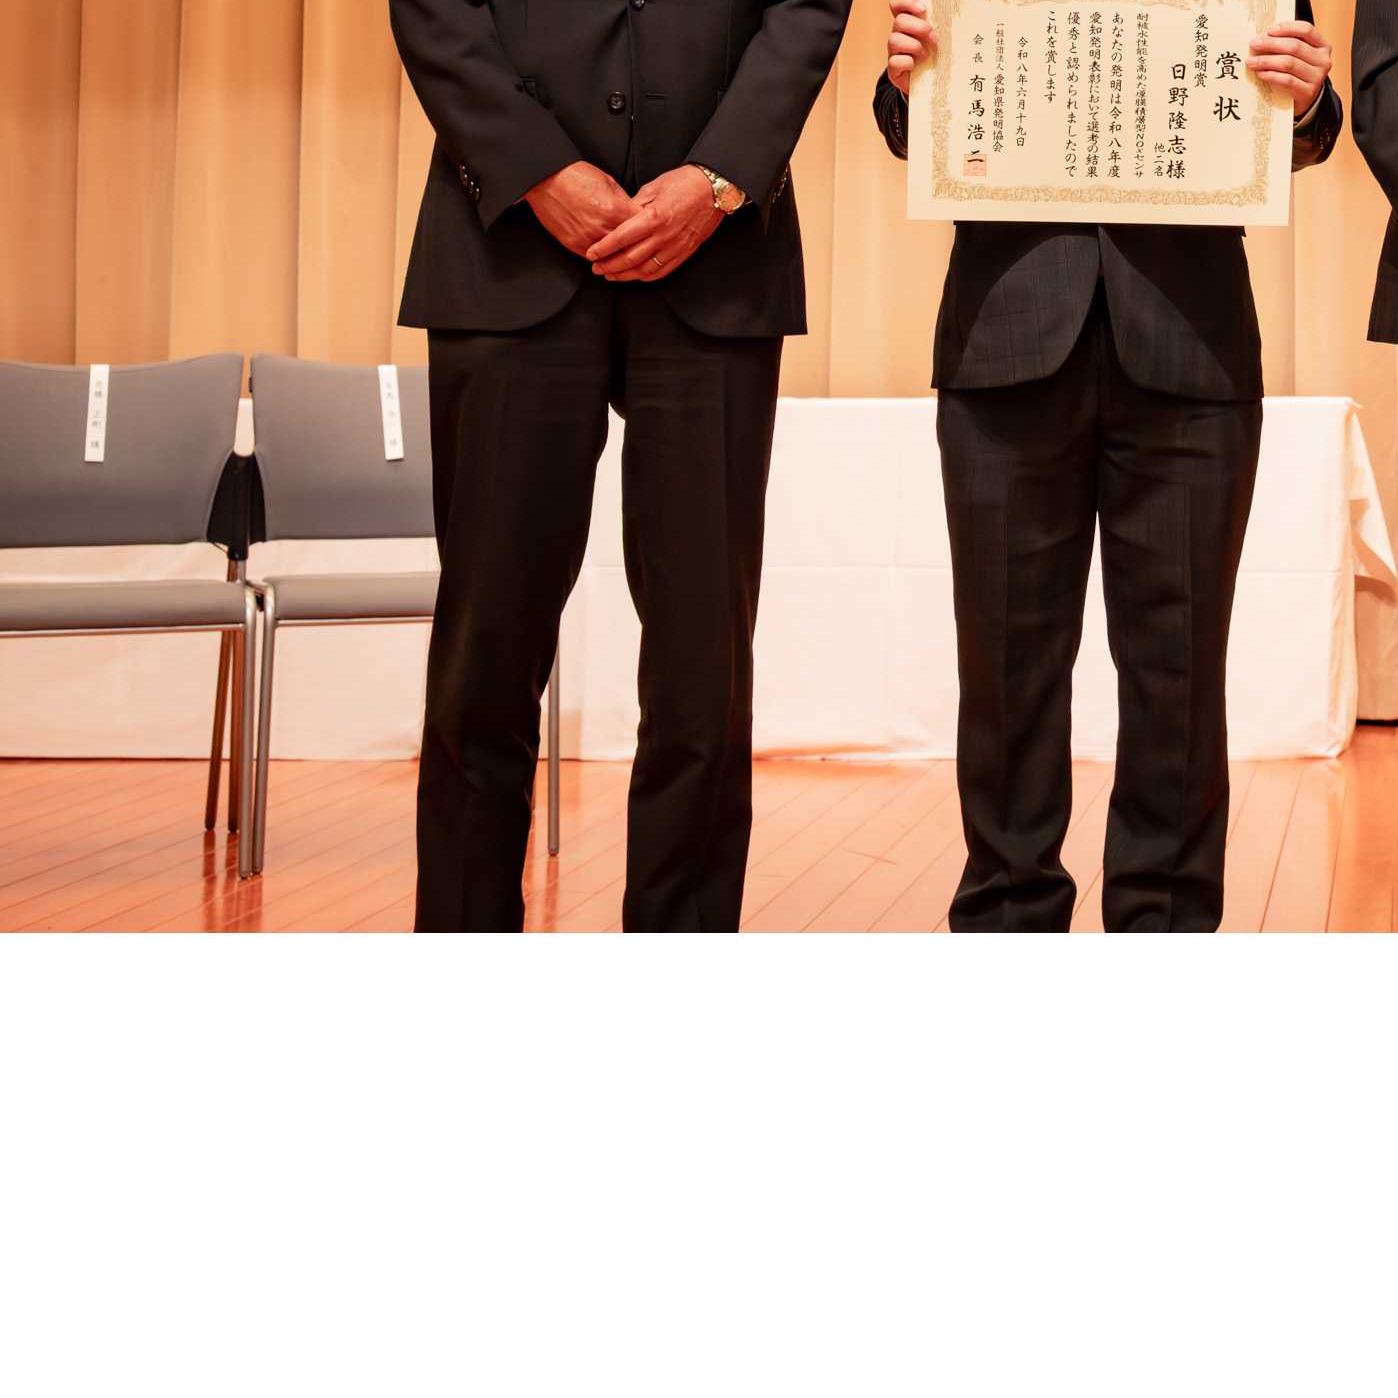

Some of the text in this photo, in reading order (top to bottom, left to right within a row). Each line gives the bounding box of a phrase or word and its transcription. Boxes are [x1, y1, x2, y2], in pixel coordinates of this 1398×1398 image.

[1015, 36, 1029, 147] 令和八年六月十九日
[1043, 10, 1059, 103] これを賞します
[1064, 11, 1081, 178] 優秀と認められましたので
[1086, 11, 1103, 178] 愛知発明表彰において選考の結果
[1107, 12, 1124, 179] あなたの発明は令和八年度
[1193, 13, 1209, 88] 愛知発明賞
[1213, 50, 1242, 123] 賞状
[1153, 142, 1166, 177] 他二名
